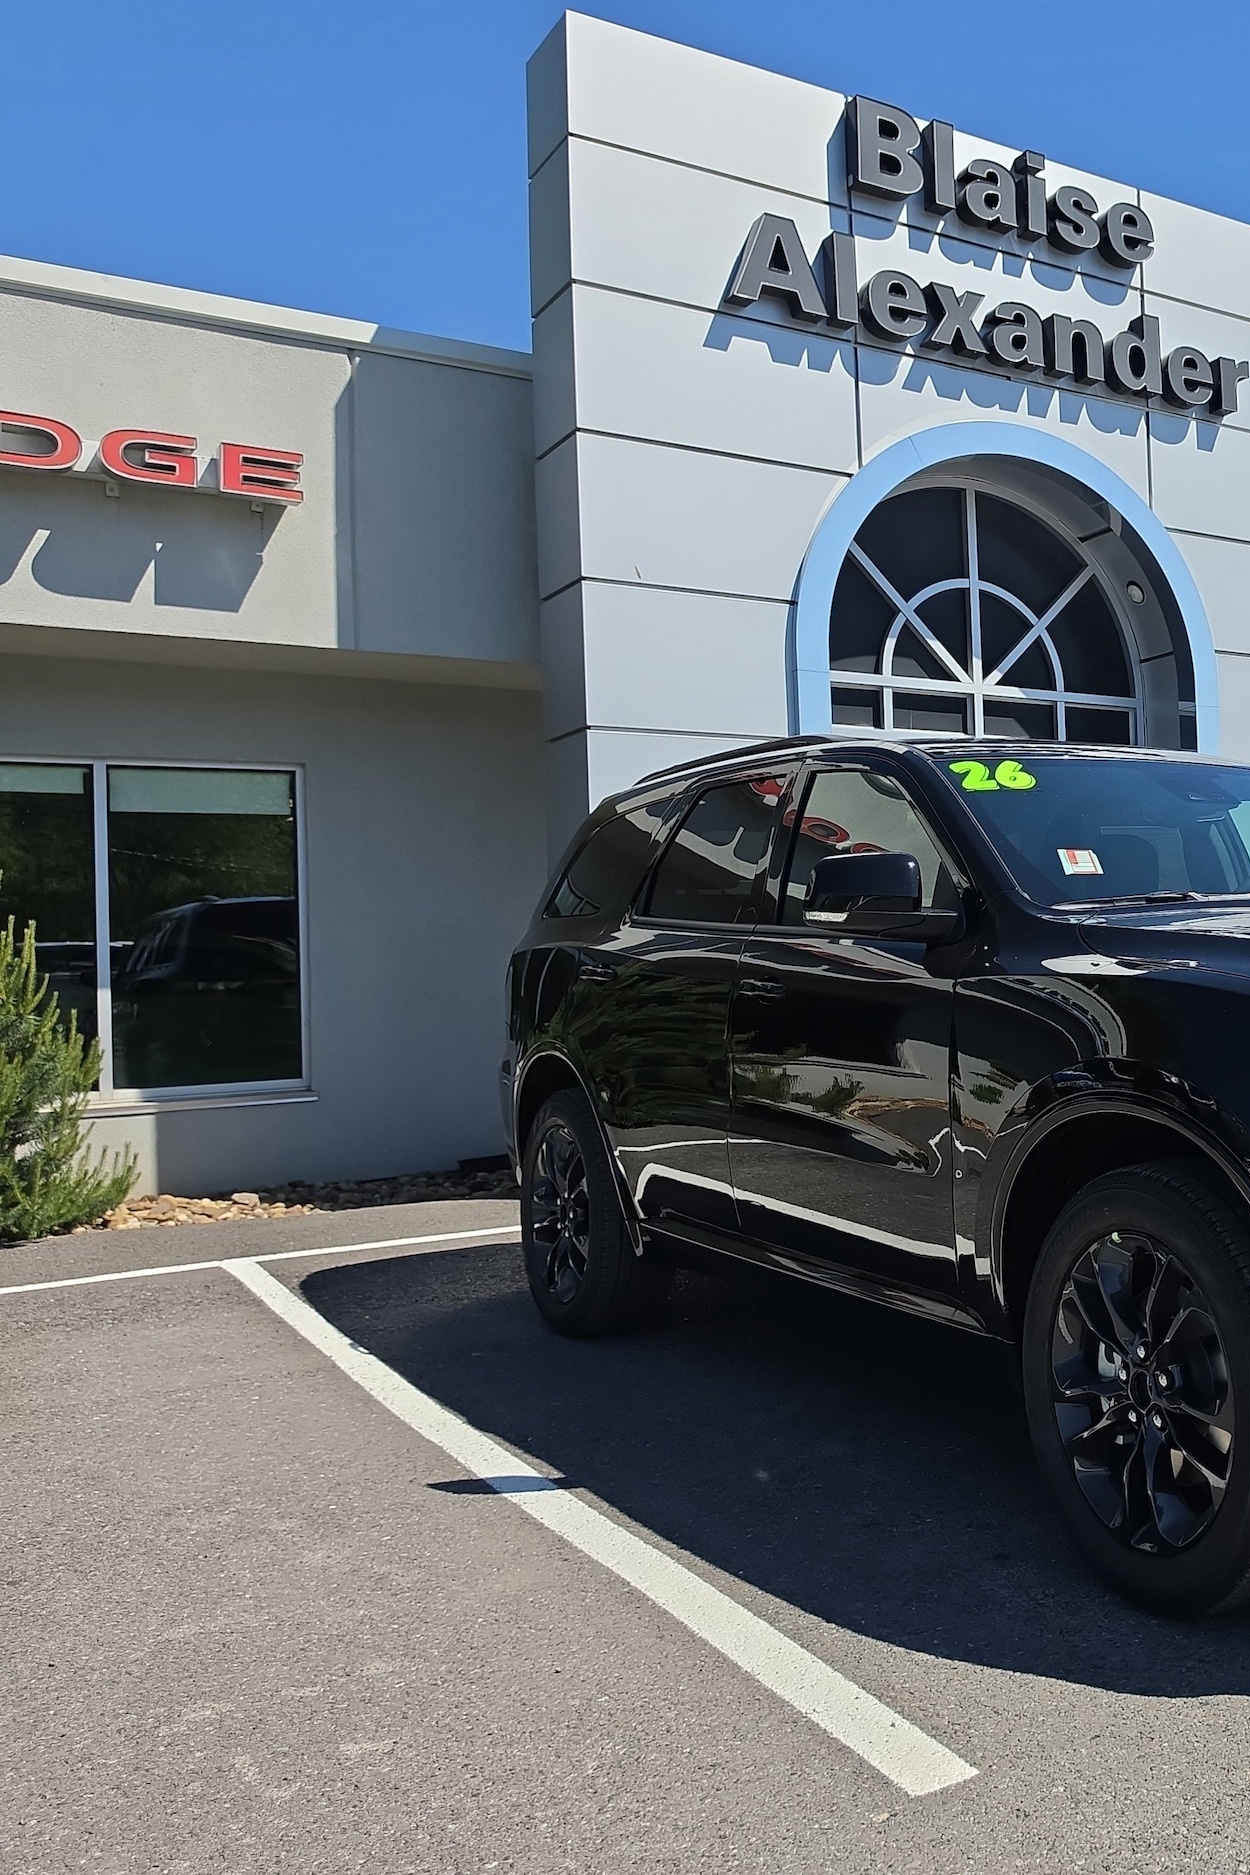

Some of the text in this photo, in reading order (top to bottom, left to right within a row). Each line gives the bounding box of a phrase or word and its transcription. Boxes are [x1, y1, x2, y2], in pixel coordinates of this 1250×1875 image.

[847, 94, 1155, 269] Blaise
[726, 212, 1250, 416] Alexander
[948, 760, 1037, 790] 26
